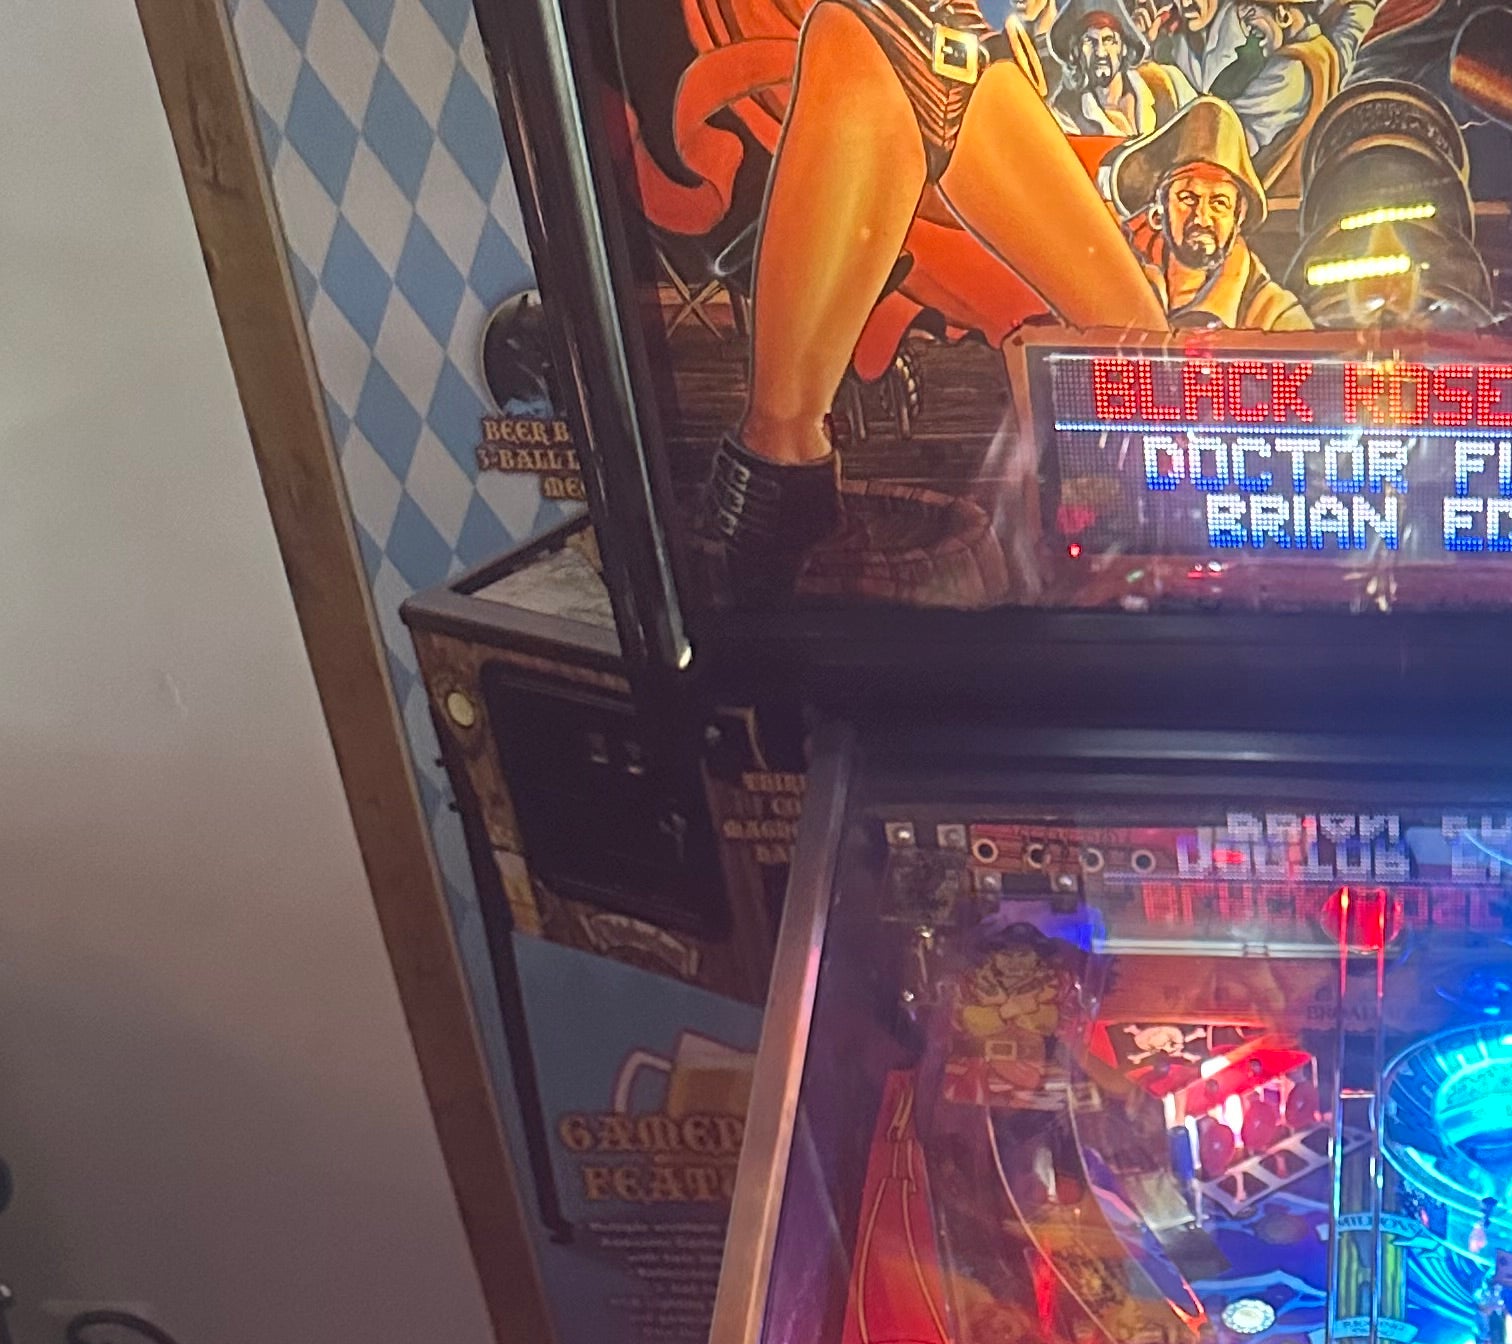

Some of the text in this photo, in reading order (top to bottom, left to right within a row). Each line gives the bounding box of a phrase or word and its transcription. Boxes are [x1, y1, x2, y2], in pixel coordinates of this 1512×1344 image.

[1091, 358, 1314, 423] BLACK
[483, 420, 549, 444] BEER
[543, 477, 586, 497] ME
[1143, 435, 1408, 494] DOCTOR
[1206, 493, 1399, 551] BRIAN
